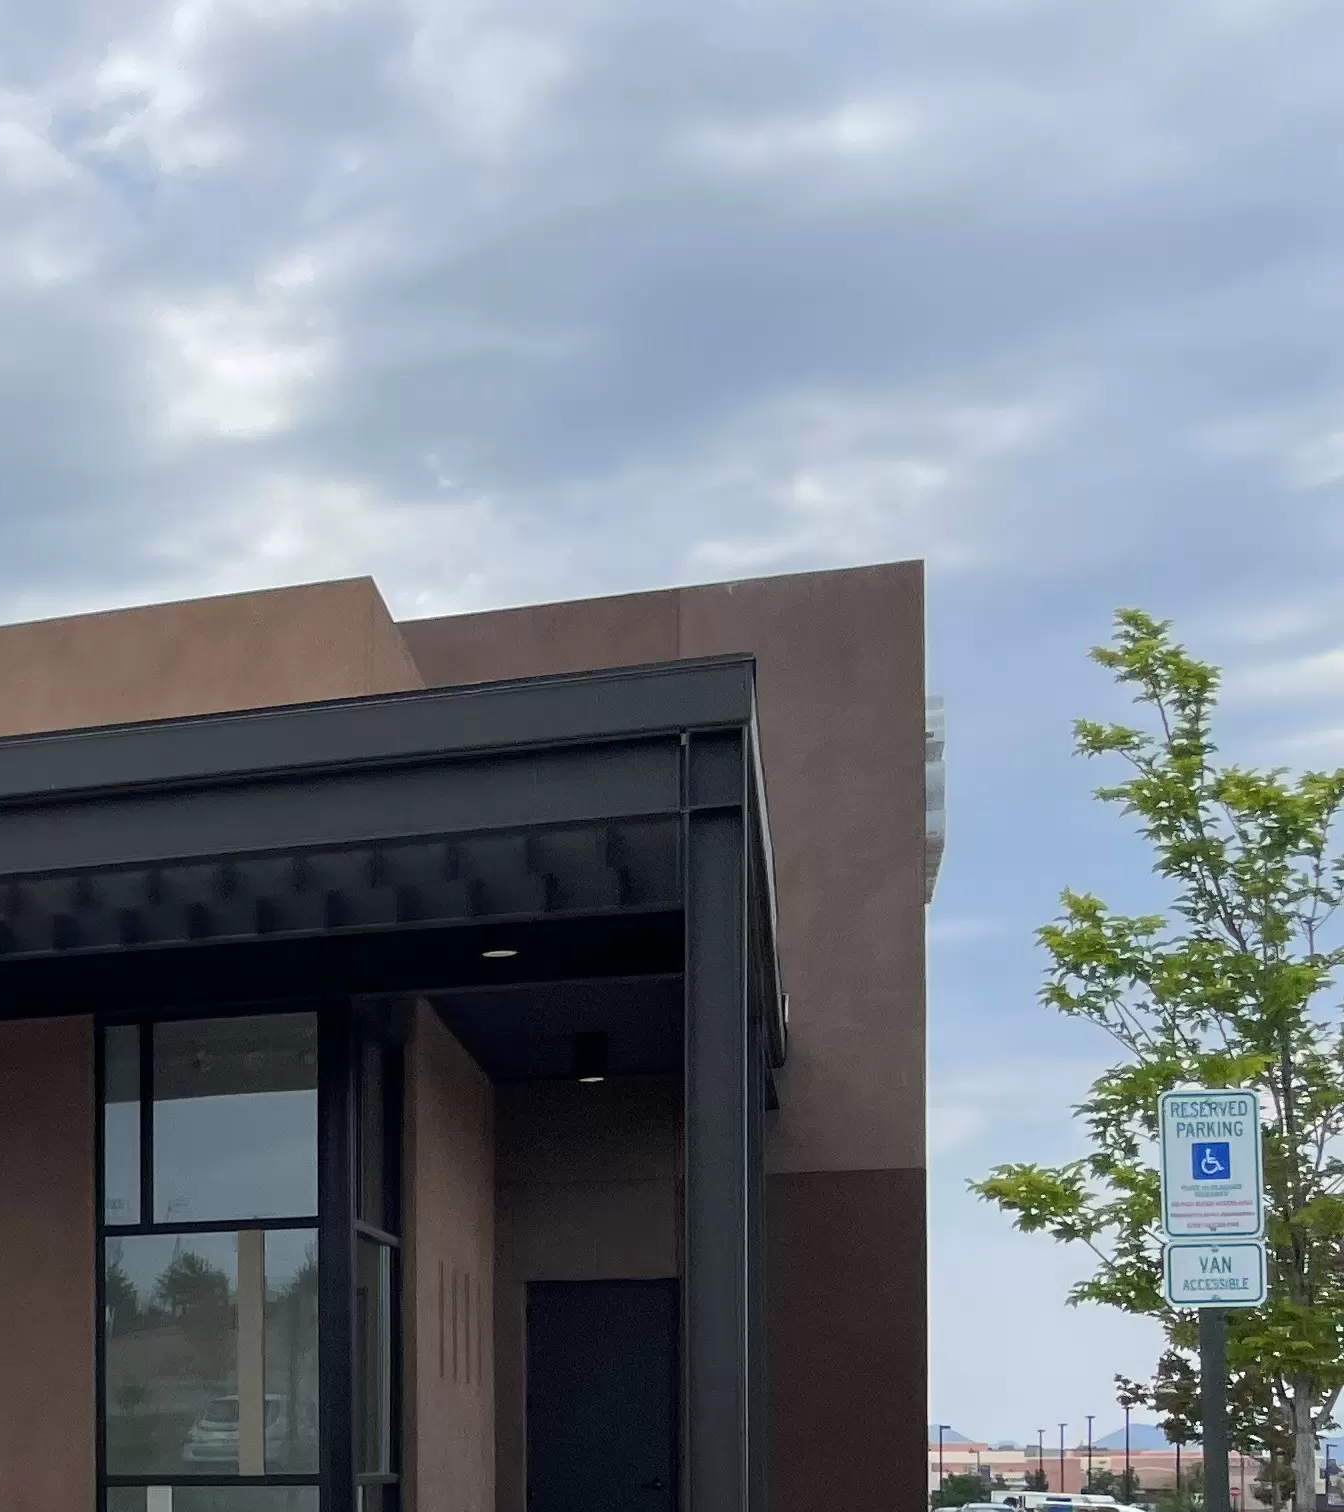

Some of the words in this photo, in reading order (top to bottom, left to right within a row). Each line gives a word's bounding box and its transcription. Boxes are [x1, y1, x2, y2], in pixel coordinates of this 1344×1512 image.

[1170, 1101, 1248, 1118] RESERVED
[1176, 1121, 1244, 1139] PARKING
[1199, 1256, 1232, 1274] VAN
[1183, 1277, 1250, 1291] ACCESSIBLE
